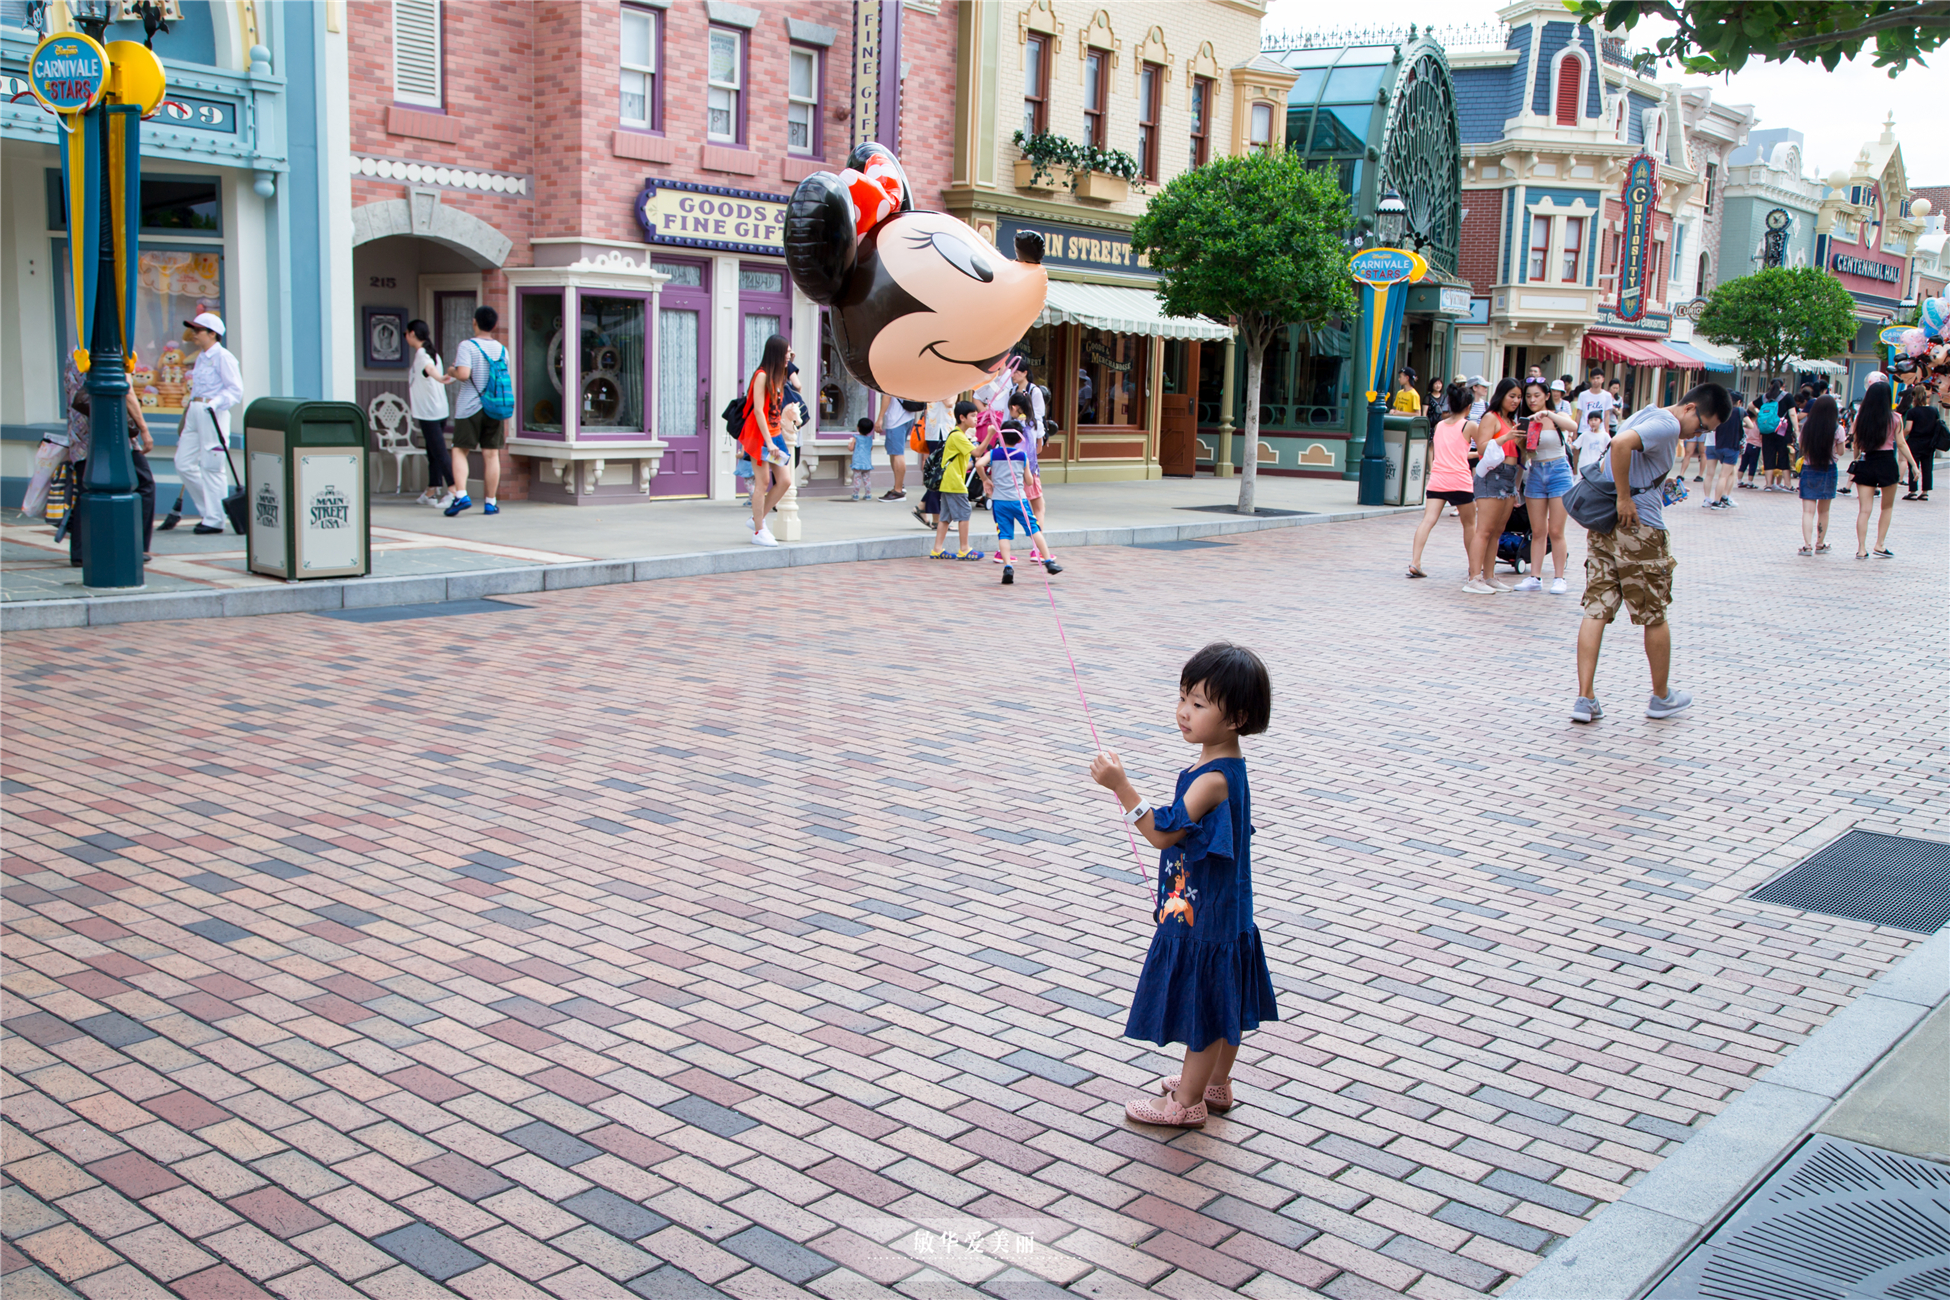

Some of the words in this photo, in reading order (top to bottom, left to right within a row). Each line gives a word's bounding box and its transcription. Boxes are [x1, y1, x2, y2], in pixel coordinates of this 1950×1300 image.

[862, 14, 873, 75] FINE
[35, 58, 99, 78] CARNIVALE
[50, 79, 91, 99] STARS
[679, 197, 767, 221] GOODS
[774, 209, 786, 224] &
[663, 213, 727, 235] FINE
[1629, 187, 1646, 287] CURIOSITY
[1068, 236, 1132, 266] STREET
[1353, 260, 1410, 269] CARNIVALE
[1365, 269, 1401, 279] STARS
[1837, 254, 1883, 280] CENTENNIAL
[1884, 265, 1900, 283] HALL
[370, 276, 397, 288] 215
[1623, 288, 1640, 297] SHOP
[259, 495, 276, 504] MAIN
[316, 498, 344, 506] MAIN
[256, 503, 279, 523] STREET
[310, 506, 349, 525] STREET
[262, 518, 275, 528] USA
[320, 519, 340, 530] USA
